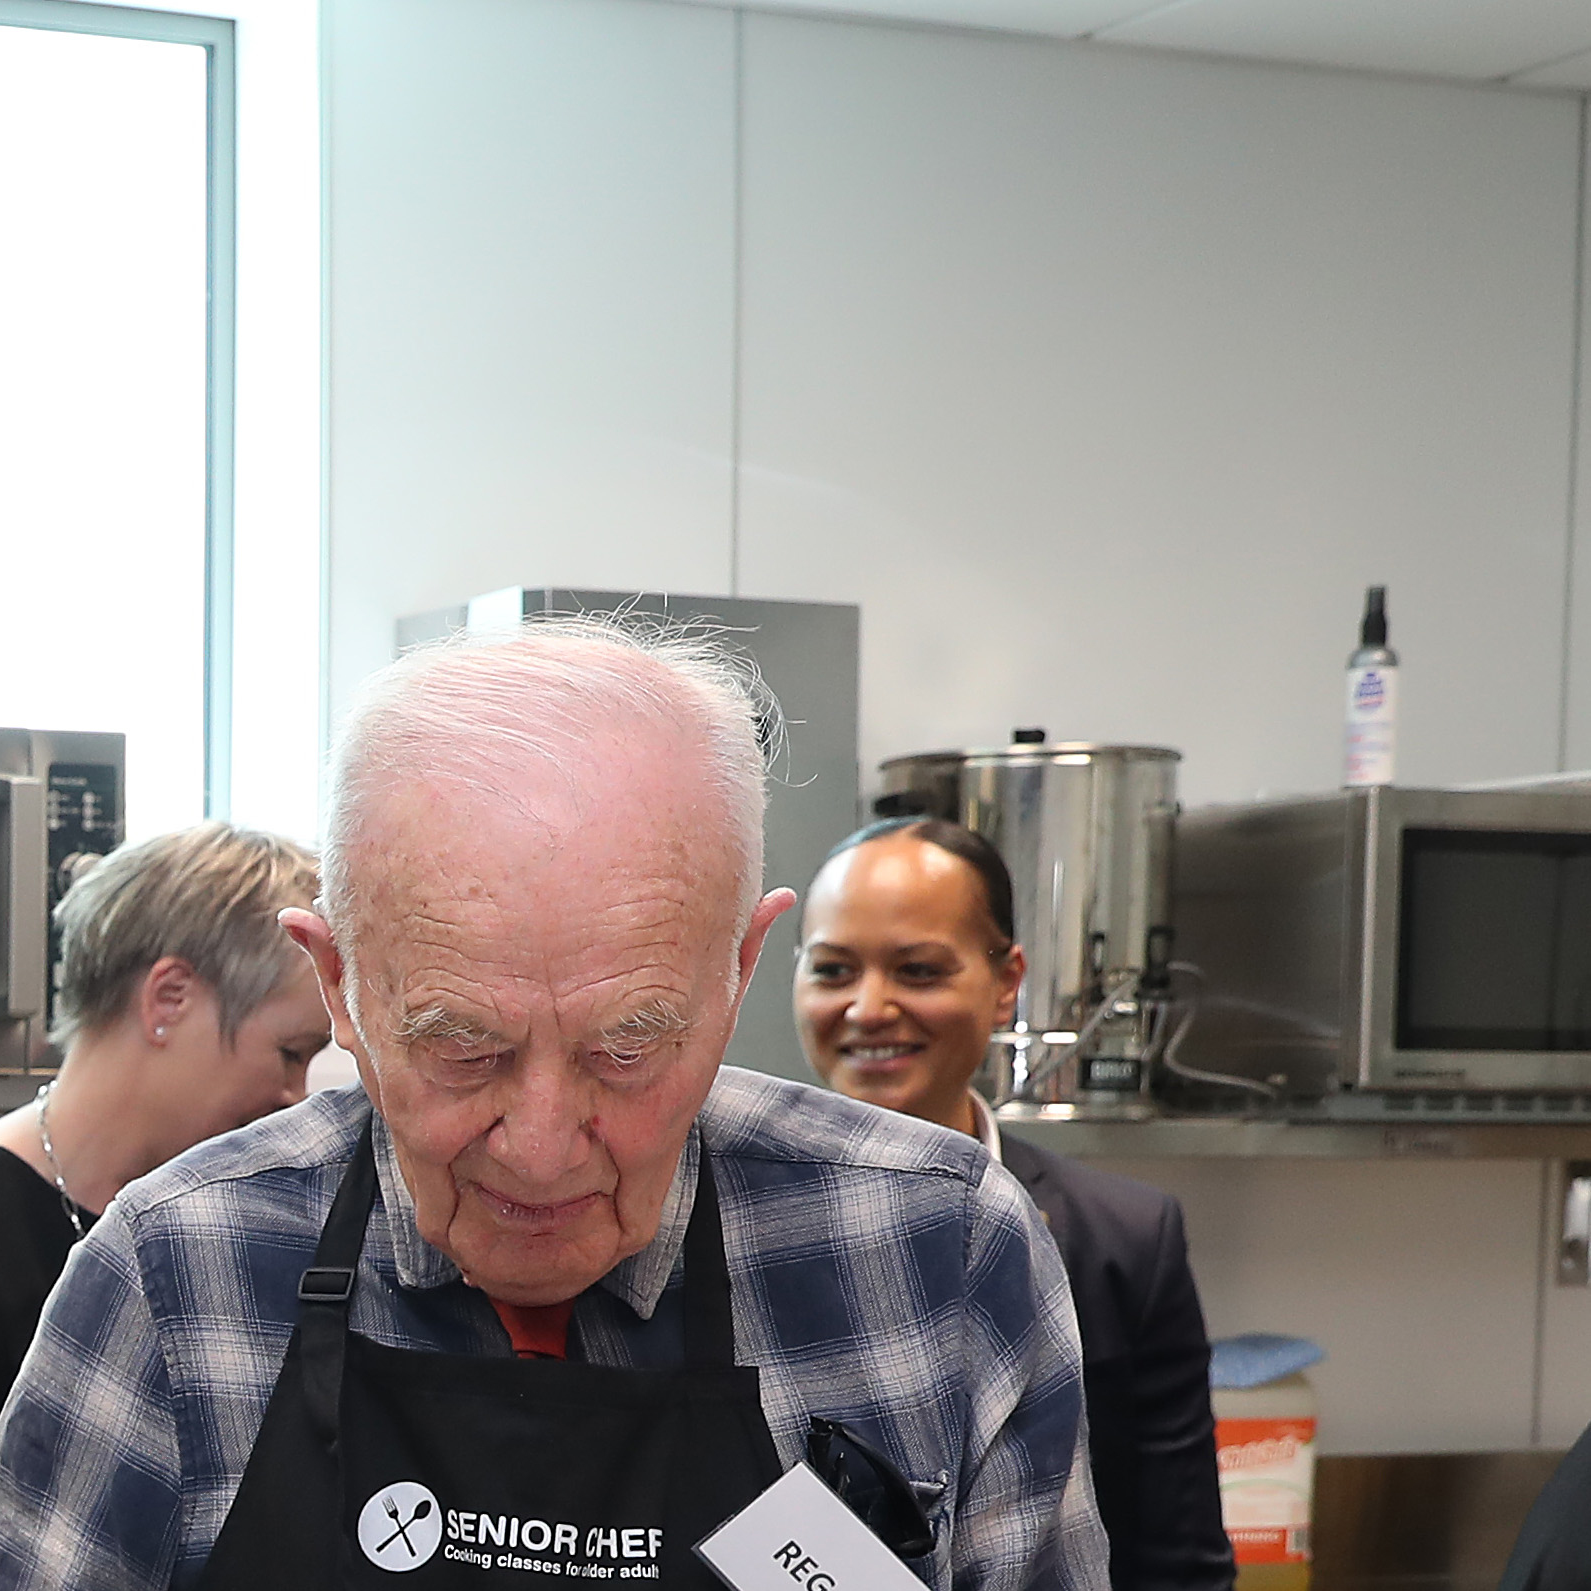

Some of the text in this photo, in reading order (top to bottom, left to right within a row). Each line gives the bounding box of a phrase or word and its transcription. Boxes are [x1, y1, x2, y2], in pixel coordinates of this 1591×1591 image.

[446, 1509, 663, 1558] SENIOR CHEF
[444, 1544, 492, 1569] Cooking
[497, 1553, 561, 1574] classes
[566, 1561, 581, 1576] for
